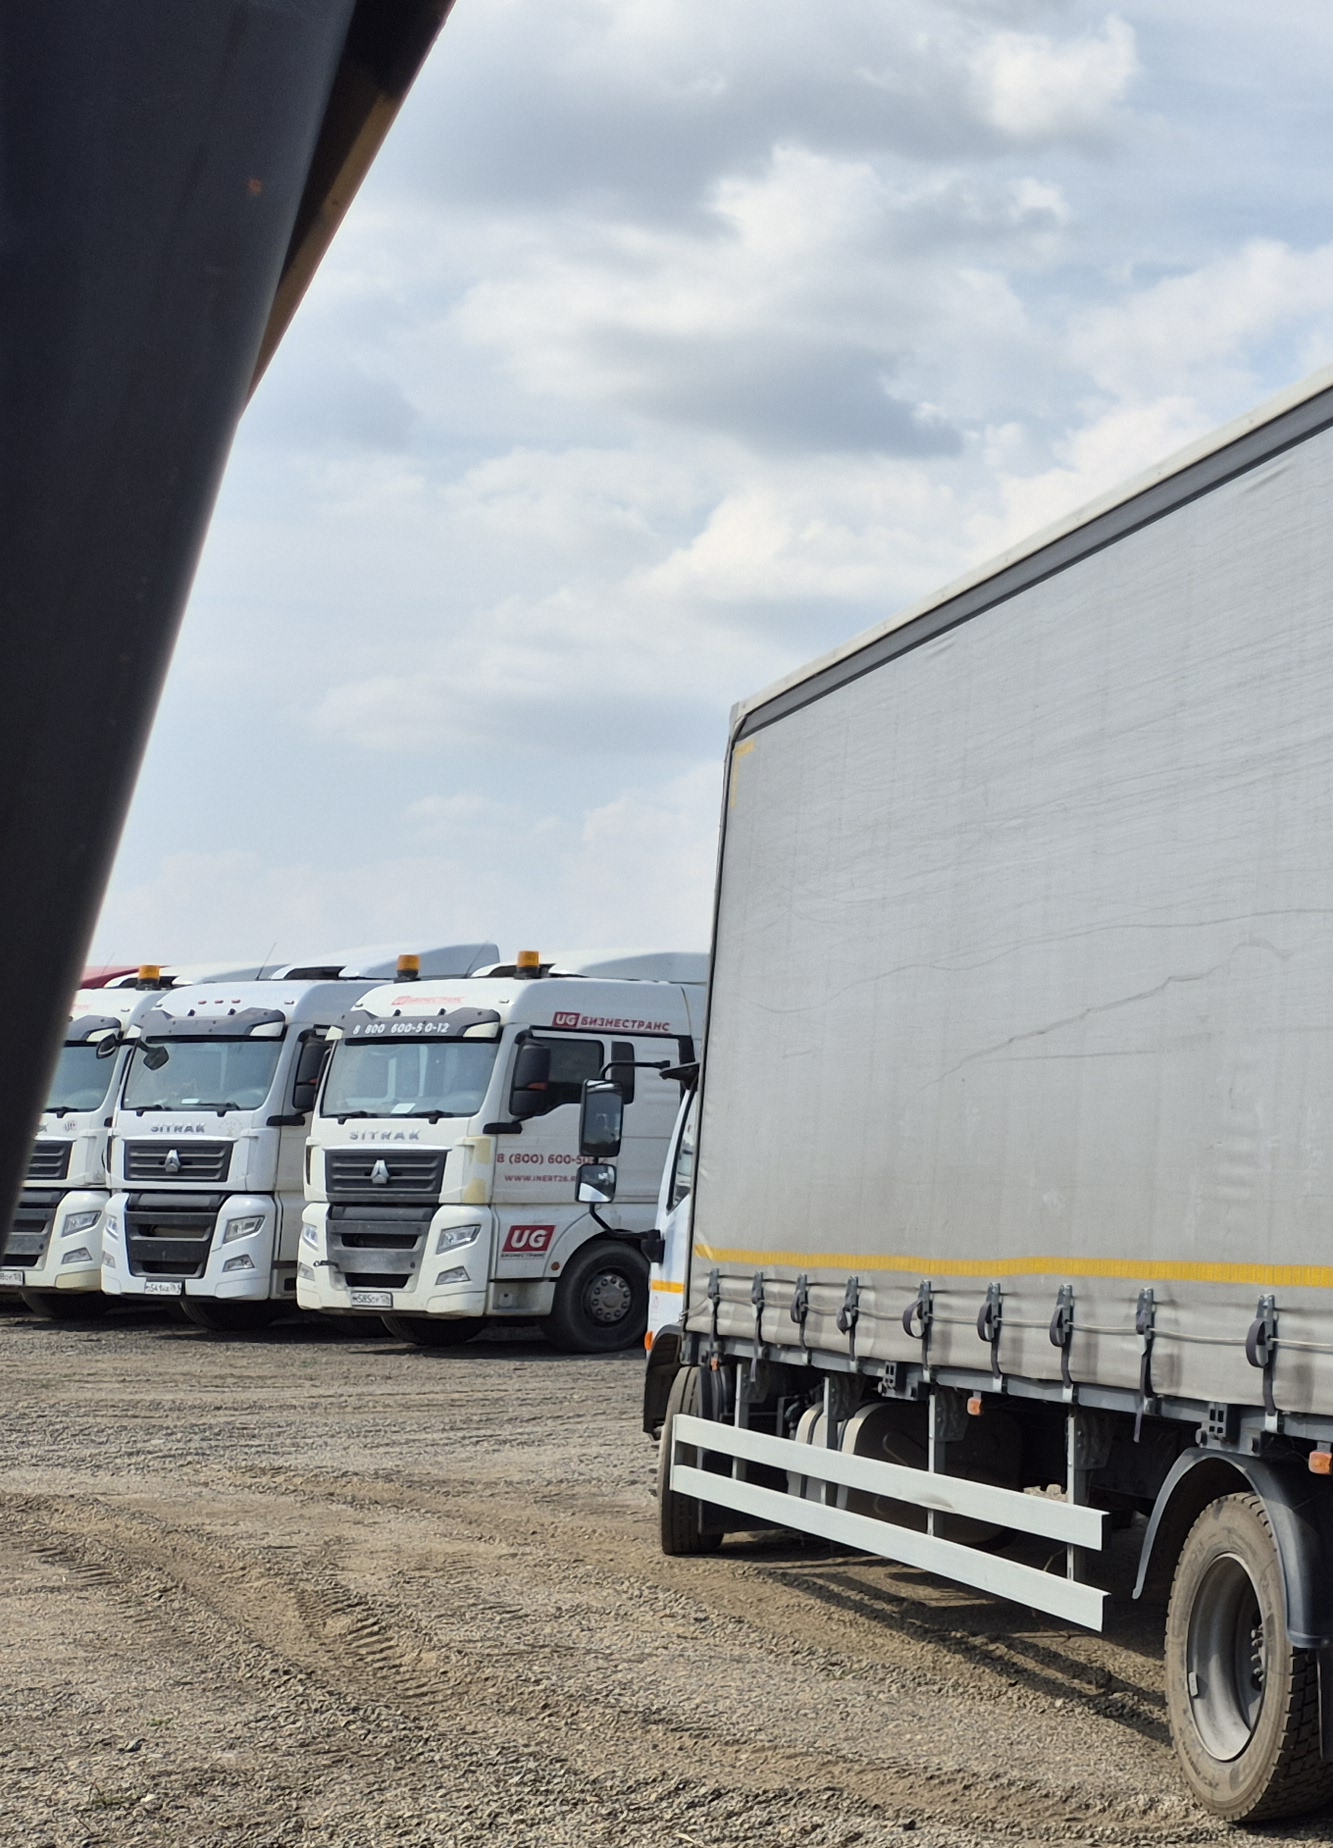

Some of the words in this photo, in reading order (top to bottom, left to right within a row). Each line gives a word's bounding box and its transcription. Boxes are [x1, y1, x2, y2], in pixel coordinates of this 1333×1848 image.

[352, 1025, 360, 1035] 8
[364, 1023, 385, 1034] 800
[554, 1013, 577, 1026] UG
[580, 1016, 671, 1032] БИЗНЕСТРАНС
[497, 1153, 505, 1163] 8
[508, 1153, 544, 1165] (800)
[510, 1229, 548, 1249] UG
